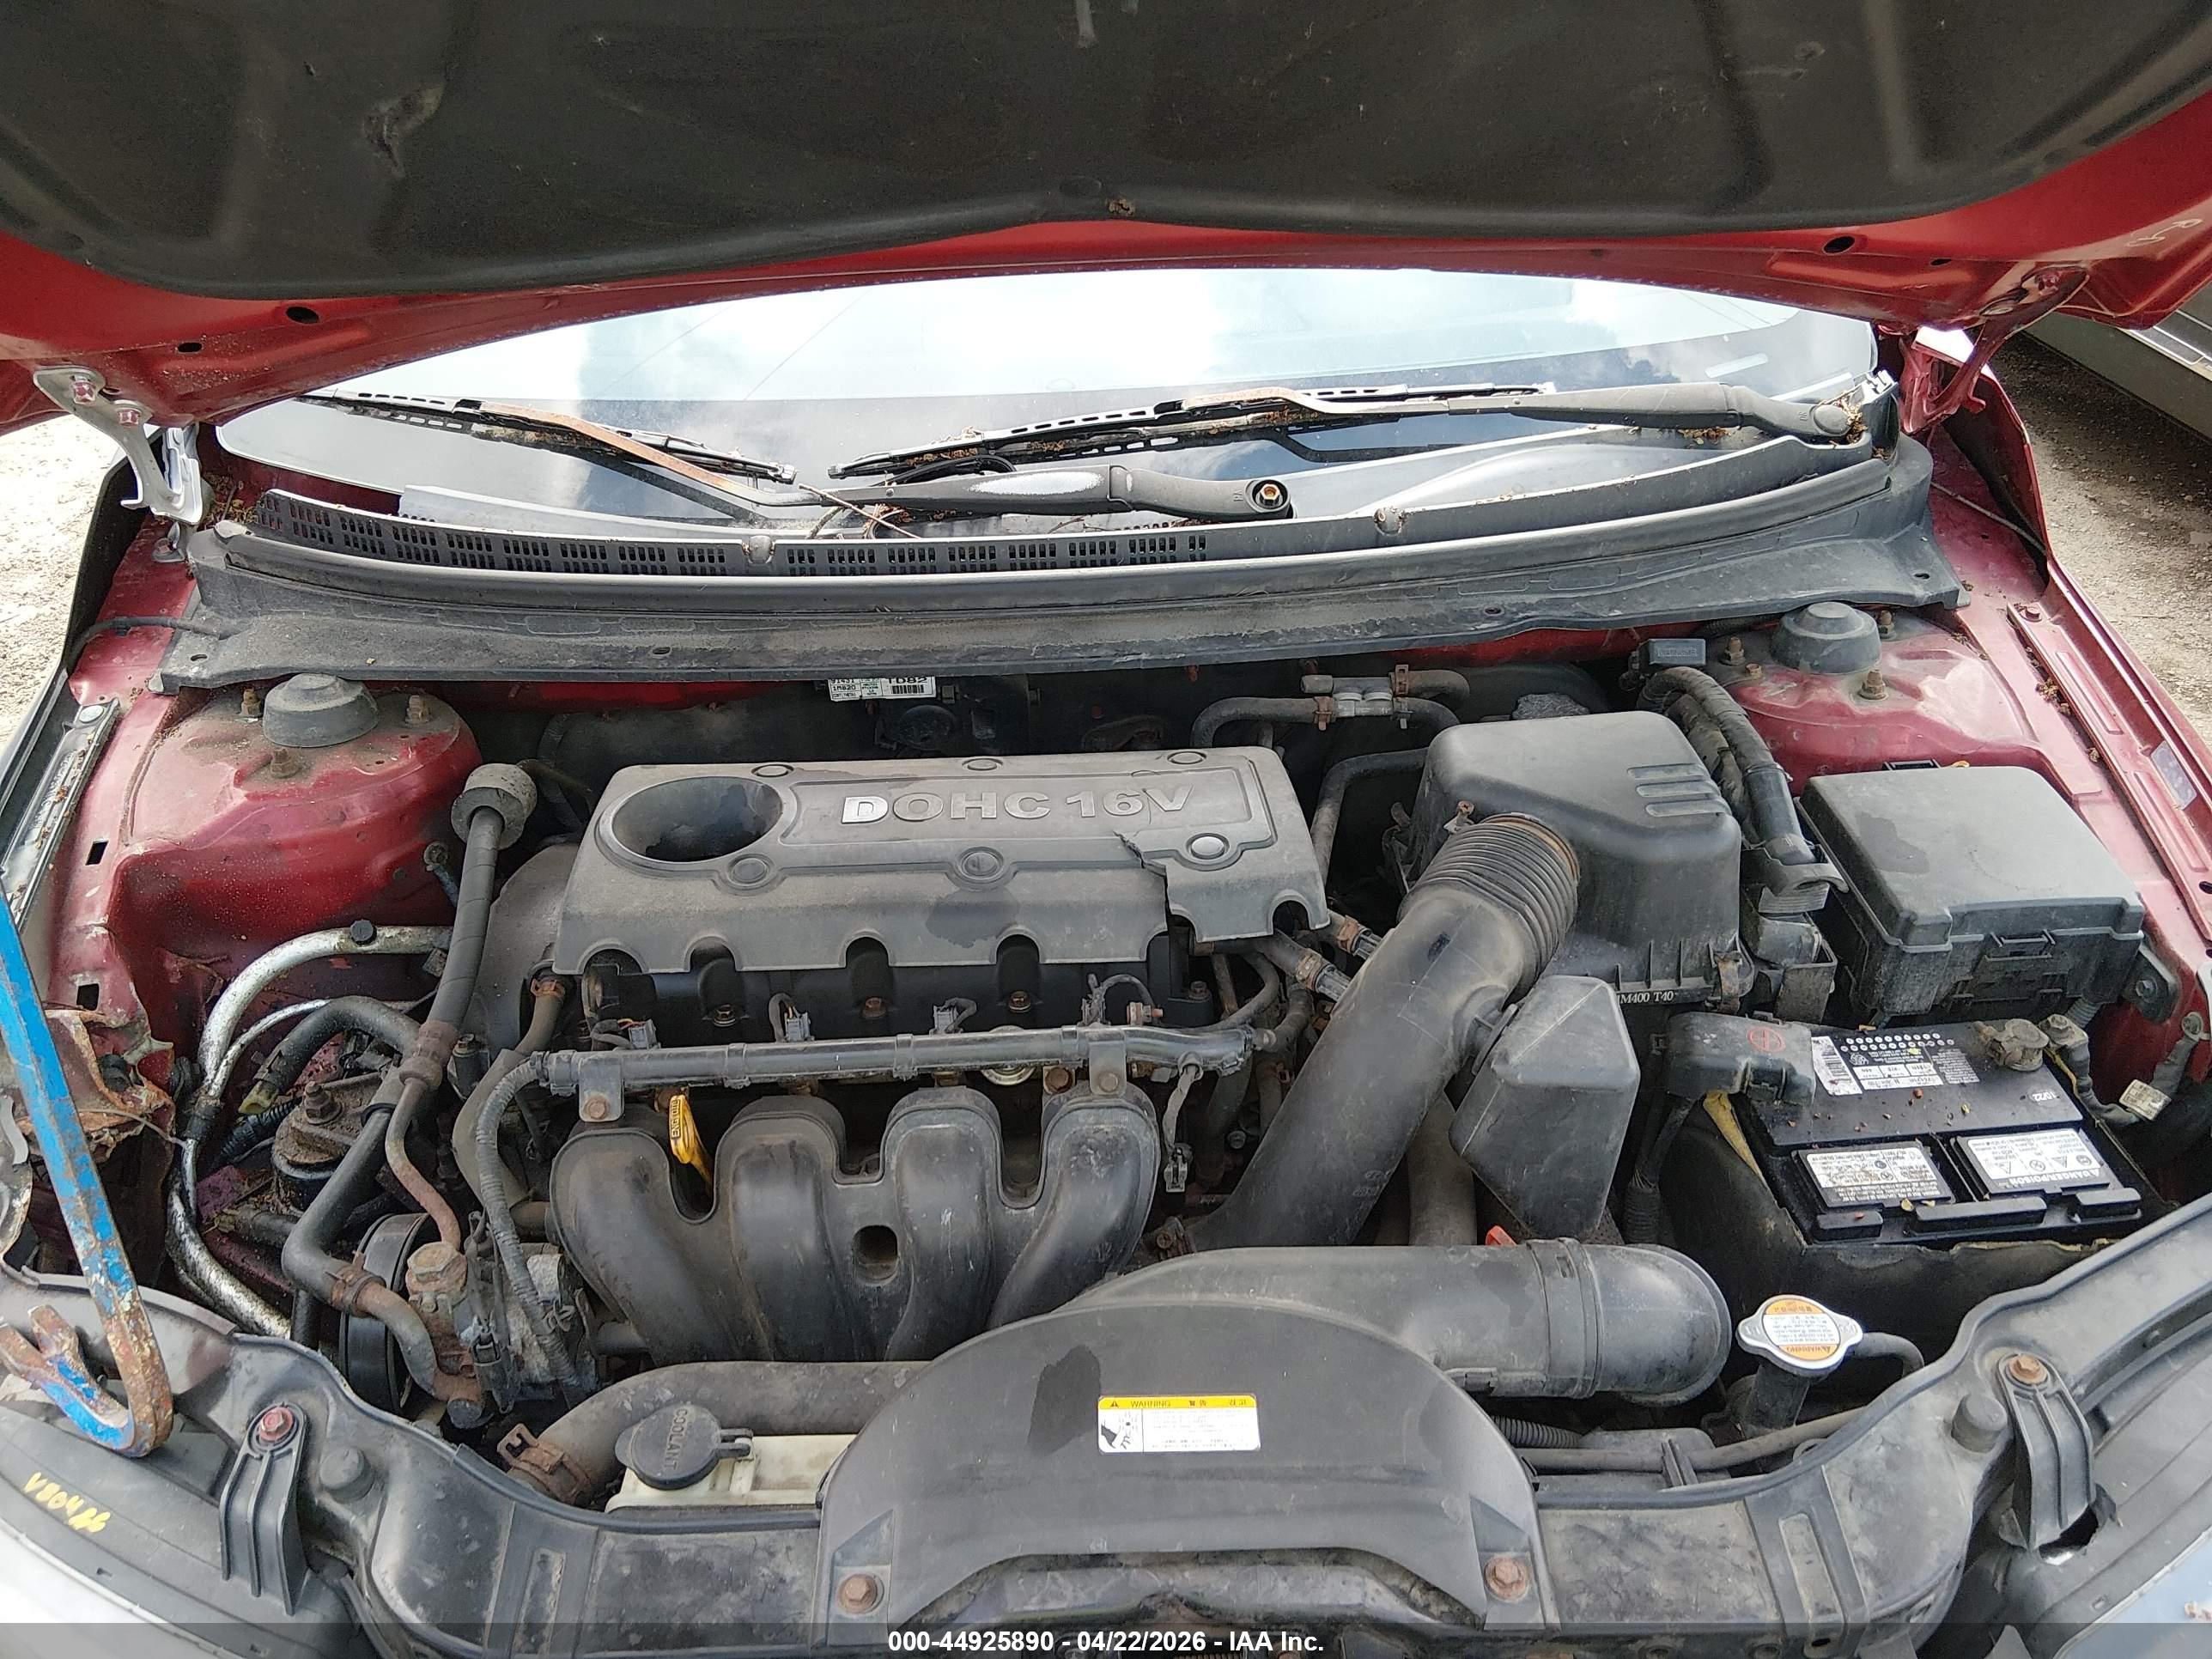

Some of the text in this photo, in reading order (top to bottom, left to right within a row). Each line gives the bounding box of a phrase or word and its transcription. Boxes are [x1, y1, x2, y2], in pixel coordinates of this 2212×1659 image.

[841, 783, 1195, 824] DOHC 16V
[664, 1408, 688, 1470] COOLANT
